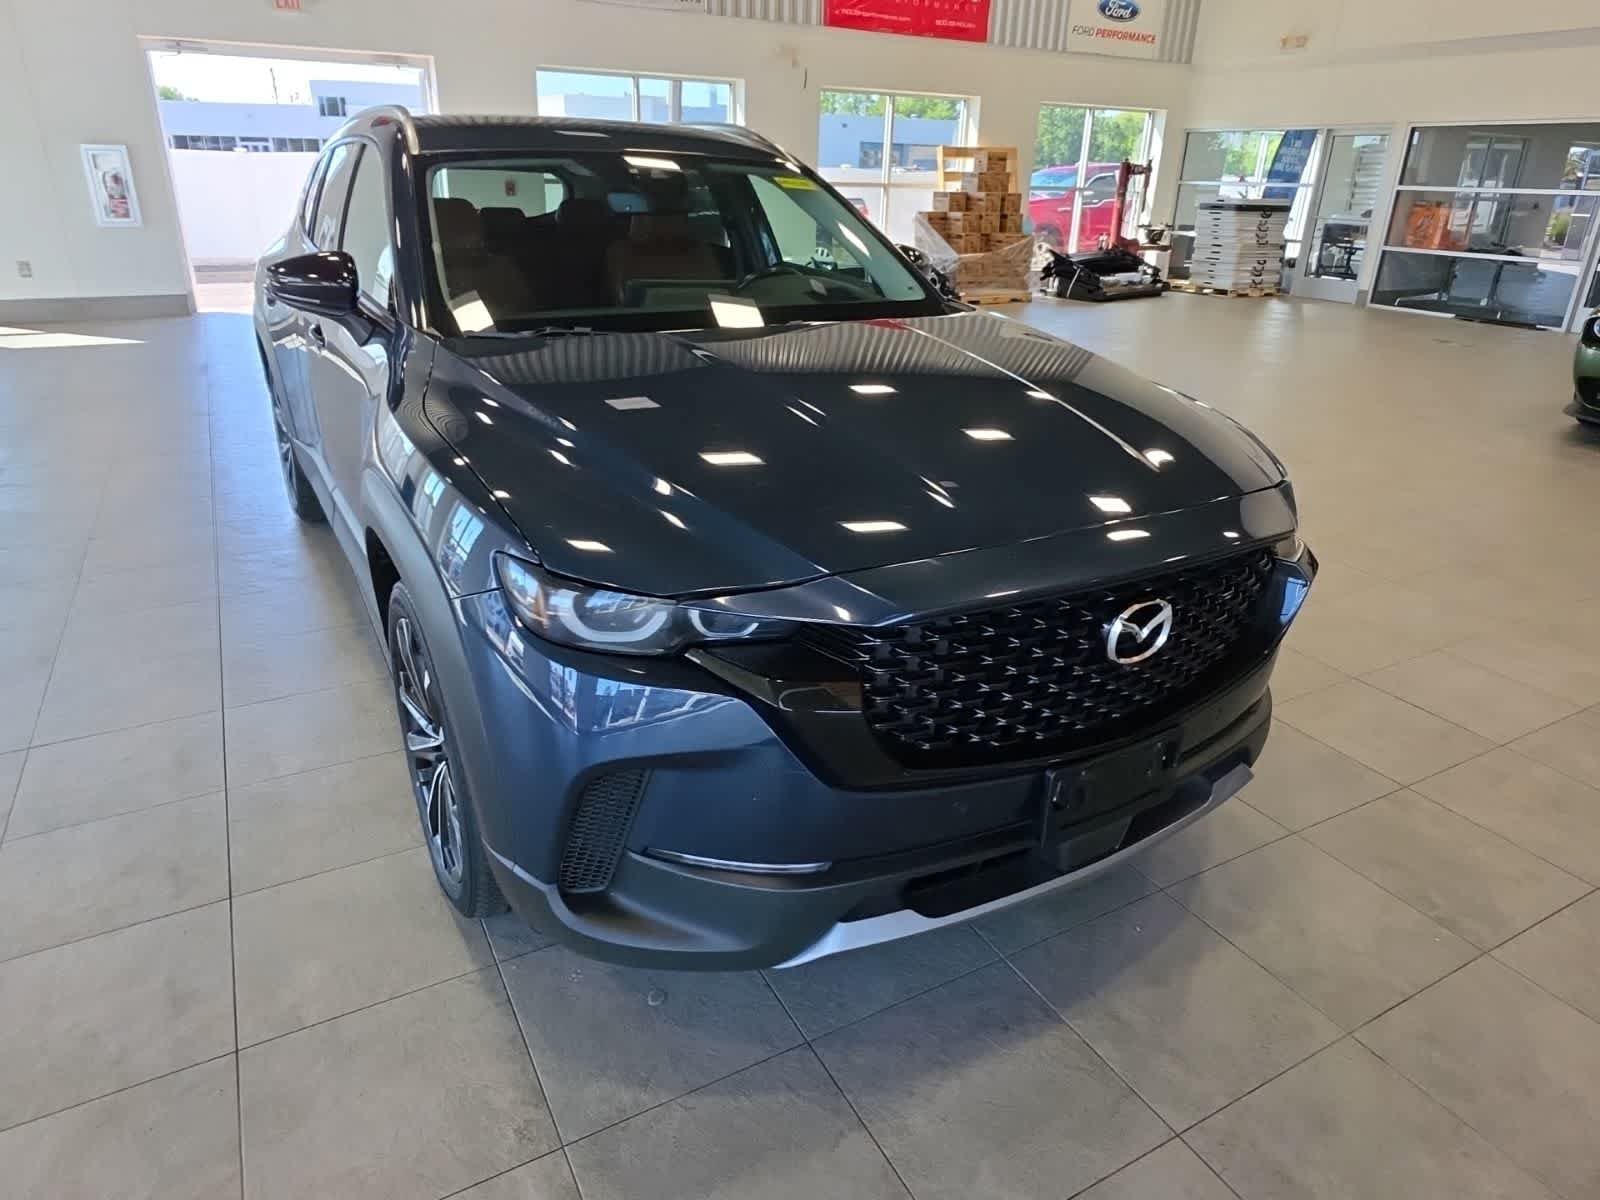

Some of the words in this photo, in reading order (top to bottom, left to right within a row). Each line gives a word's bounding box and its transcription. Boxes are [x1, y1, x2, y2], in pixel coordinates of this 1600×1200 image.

[1105, 0, 1133, 18] Ford
[1072, 25, 1096, 37] FORD
[1095, 27, 1157, 44] PERFORMANCE
